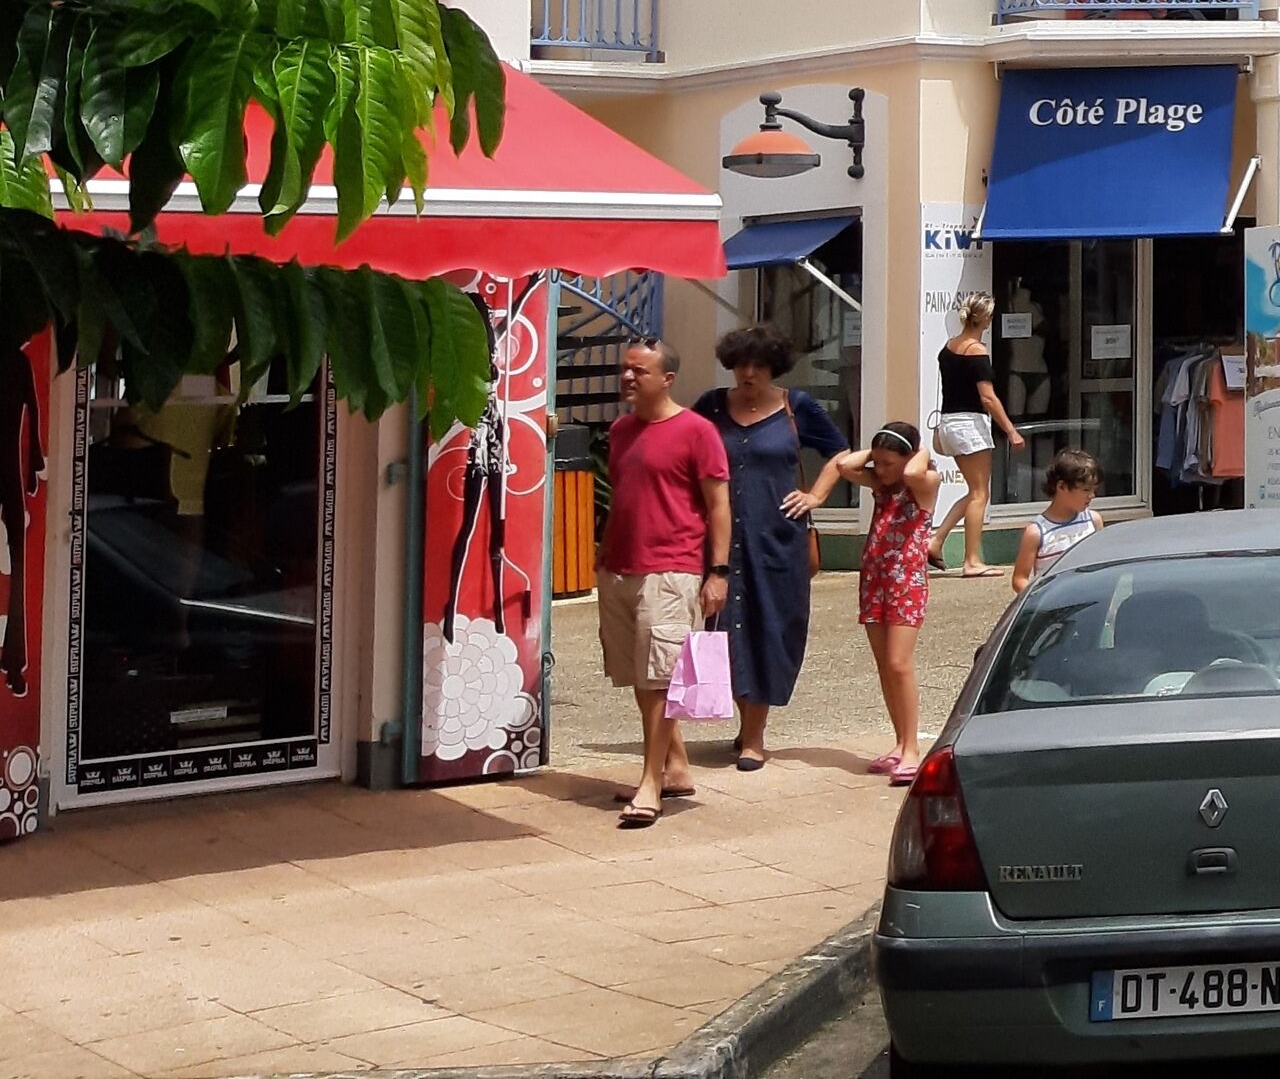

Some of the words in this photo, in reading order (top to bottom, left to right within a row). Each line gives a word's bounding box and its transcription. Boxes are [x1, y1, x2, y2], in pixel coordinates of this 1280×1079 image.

[1029, 98, 1104, 126] Côté
[1113, 98, 1203, 132] Plage
[999, 864, 1084, 882] RENAULT
